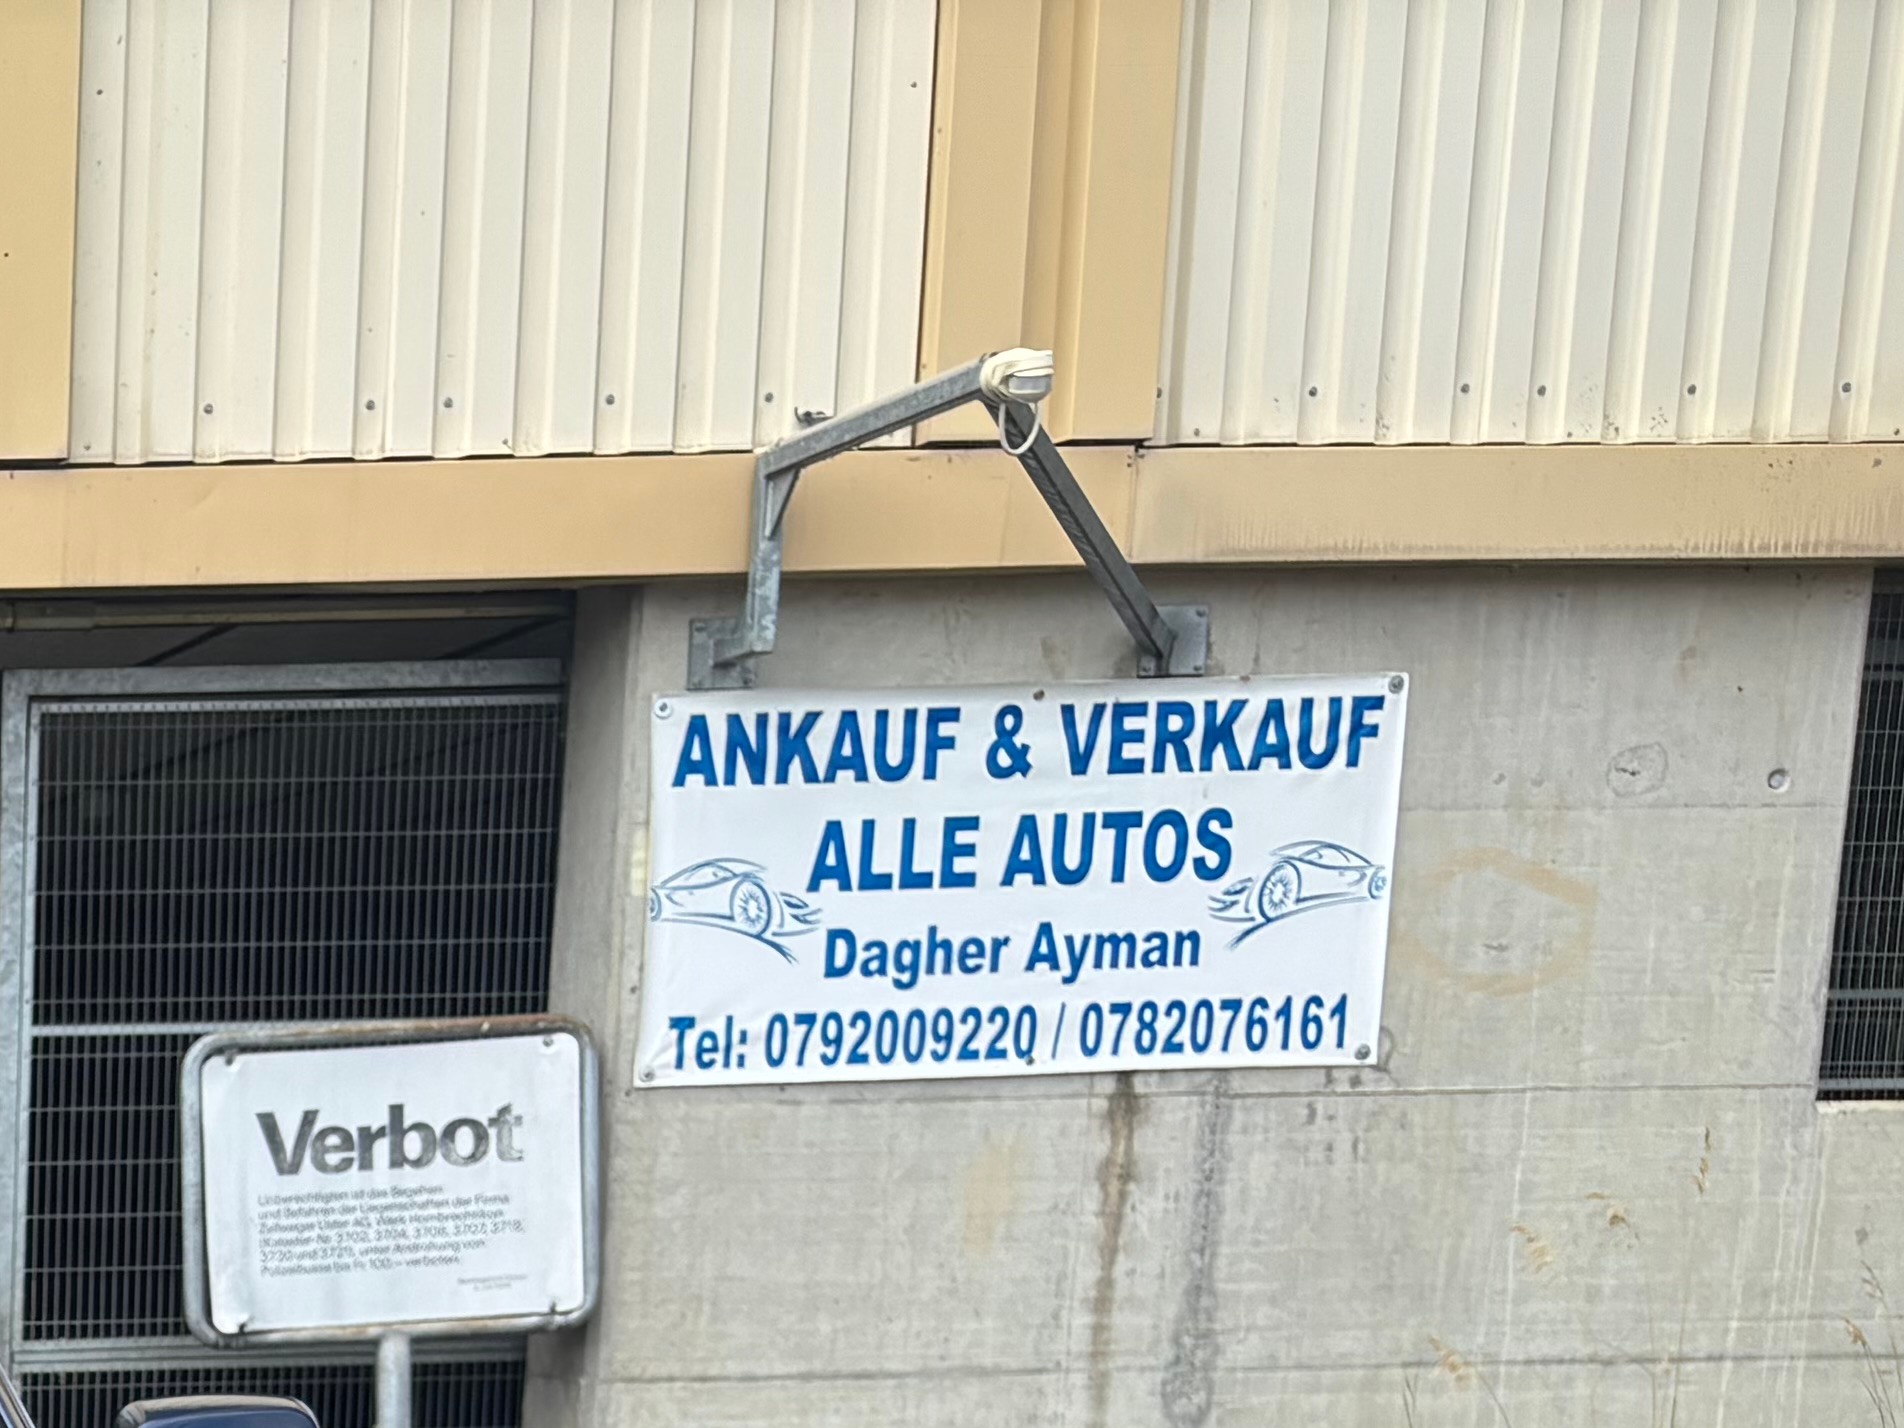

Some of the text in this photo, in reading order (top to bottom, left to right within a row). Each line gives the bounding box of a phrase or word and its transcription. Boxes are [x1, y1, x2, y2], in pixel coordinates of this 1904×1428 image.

[673, 696, 1384, 788] ANKAUF & VERKAUF
[807, 808, 1237, 893] ALLE AUTOS
[824, 922, 1201, 990] Dagher Ayman
[669, 996, 1347, 1070] Tel: 0792009220 / 0782076161
[256, 1102, 524, 1176] Verbot
